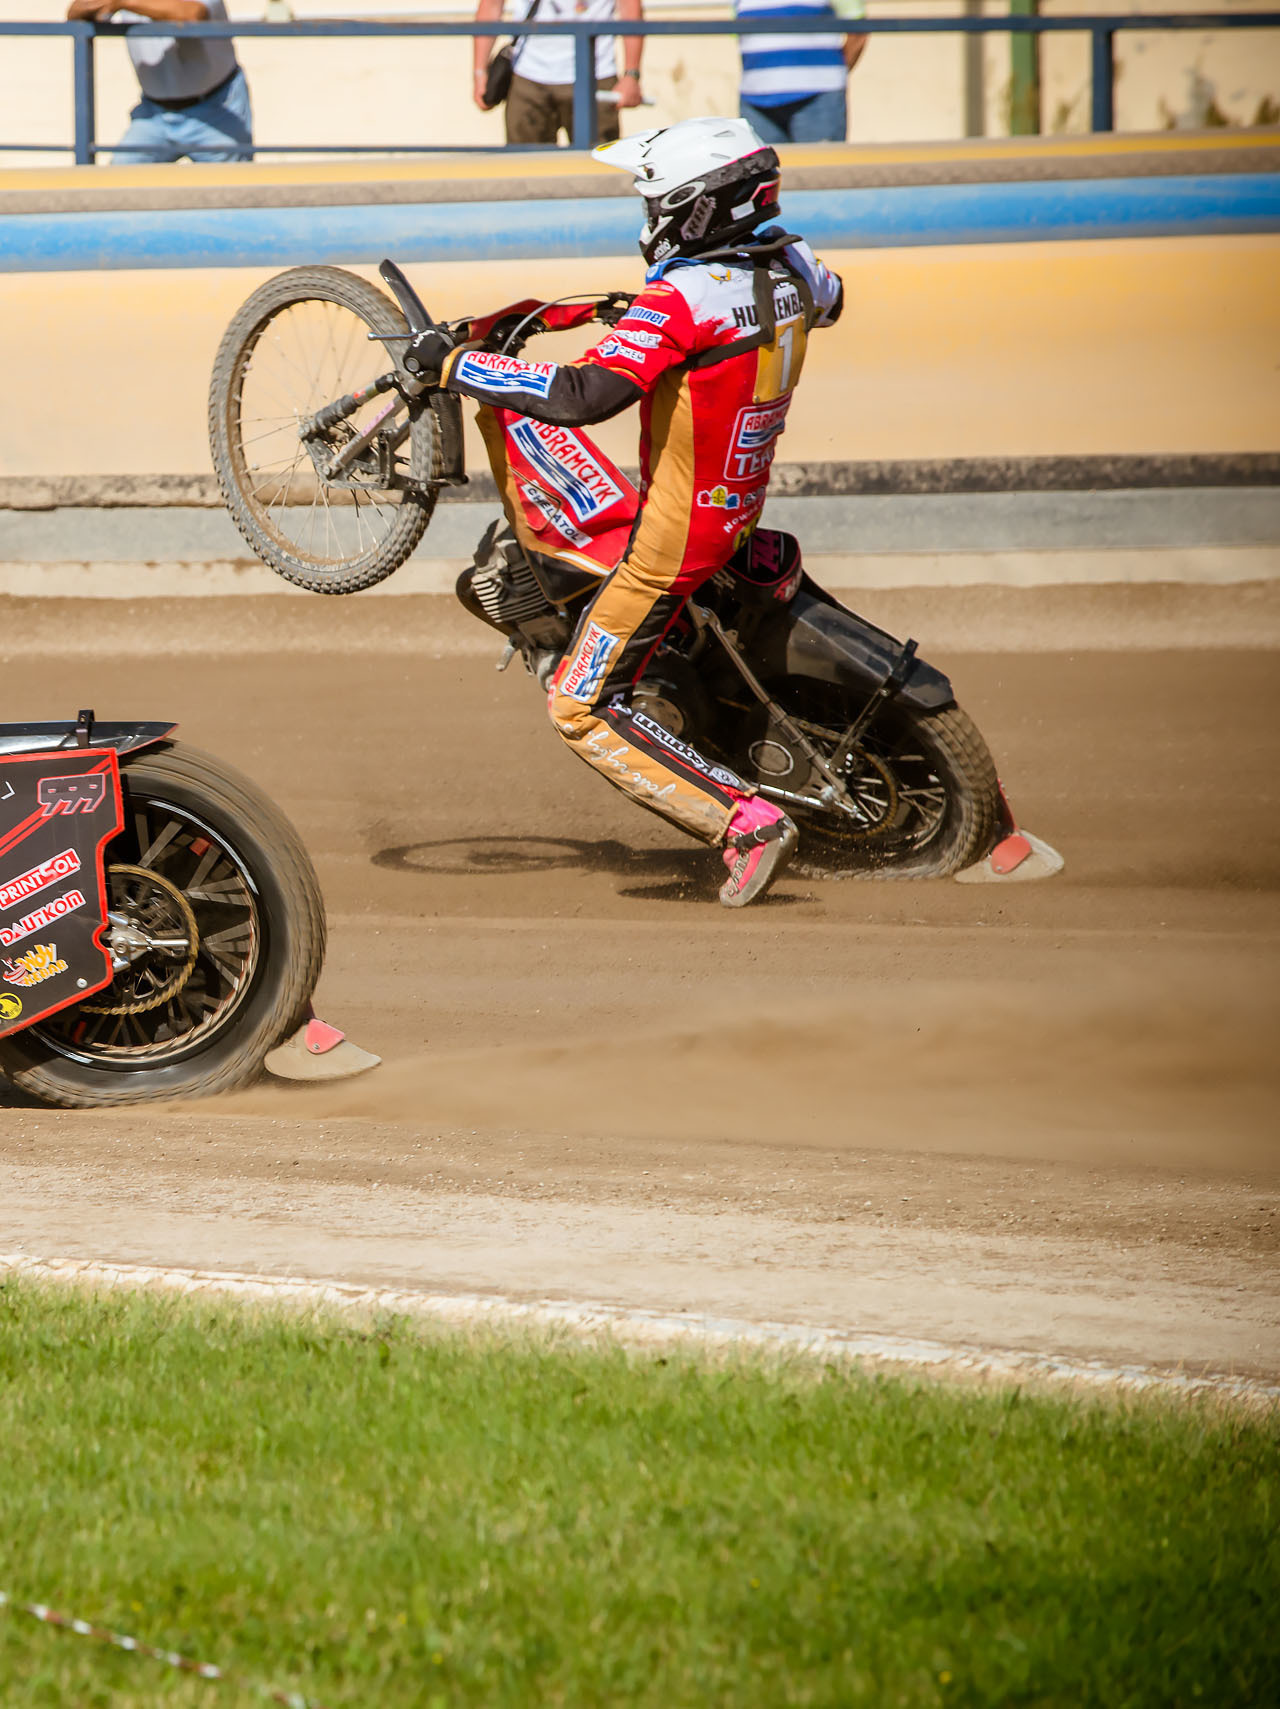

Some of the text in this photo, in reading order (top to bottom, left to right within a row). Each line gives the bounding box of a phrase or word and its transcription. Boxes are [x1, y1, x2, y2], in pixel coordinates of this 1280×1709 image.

[466, 352, 554, 377] ABRAMZYK
[529, 418, 618, 504] ABRAMCZYK
[735, 446, 776, 477] TEA
[527, 488, 582, 542] CHELATOL
[565, 627, 602, 694] ABRAMCZYK
[15, 943, 58, 973] WOW
